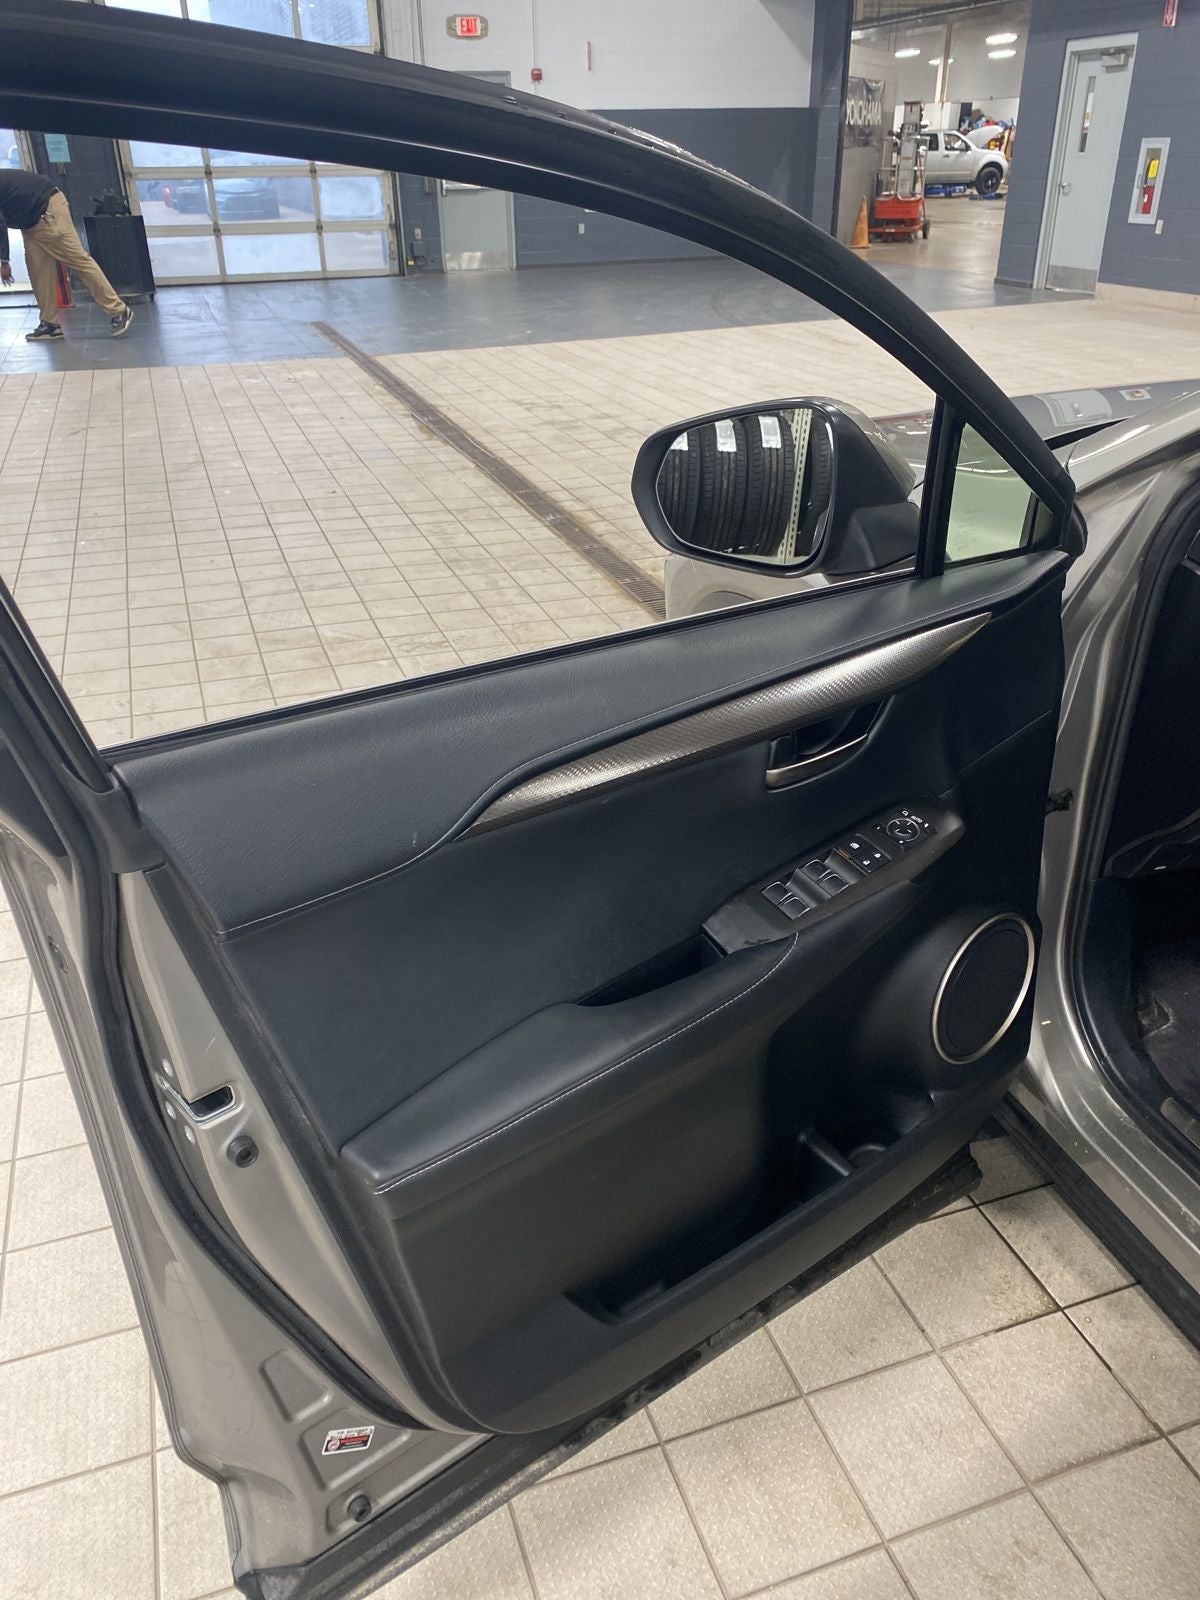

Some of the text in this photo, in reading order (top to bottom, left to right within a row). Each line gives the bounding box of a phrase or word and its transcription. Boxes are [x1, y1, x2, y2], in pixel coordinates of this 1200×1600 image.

[460, 18, 478, 34] EXIT
[845, 99, 882, 126] YOKOHAMA
[909, 815, 923, 824] AUTO
